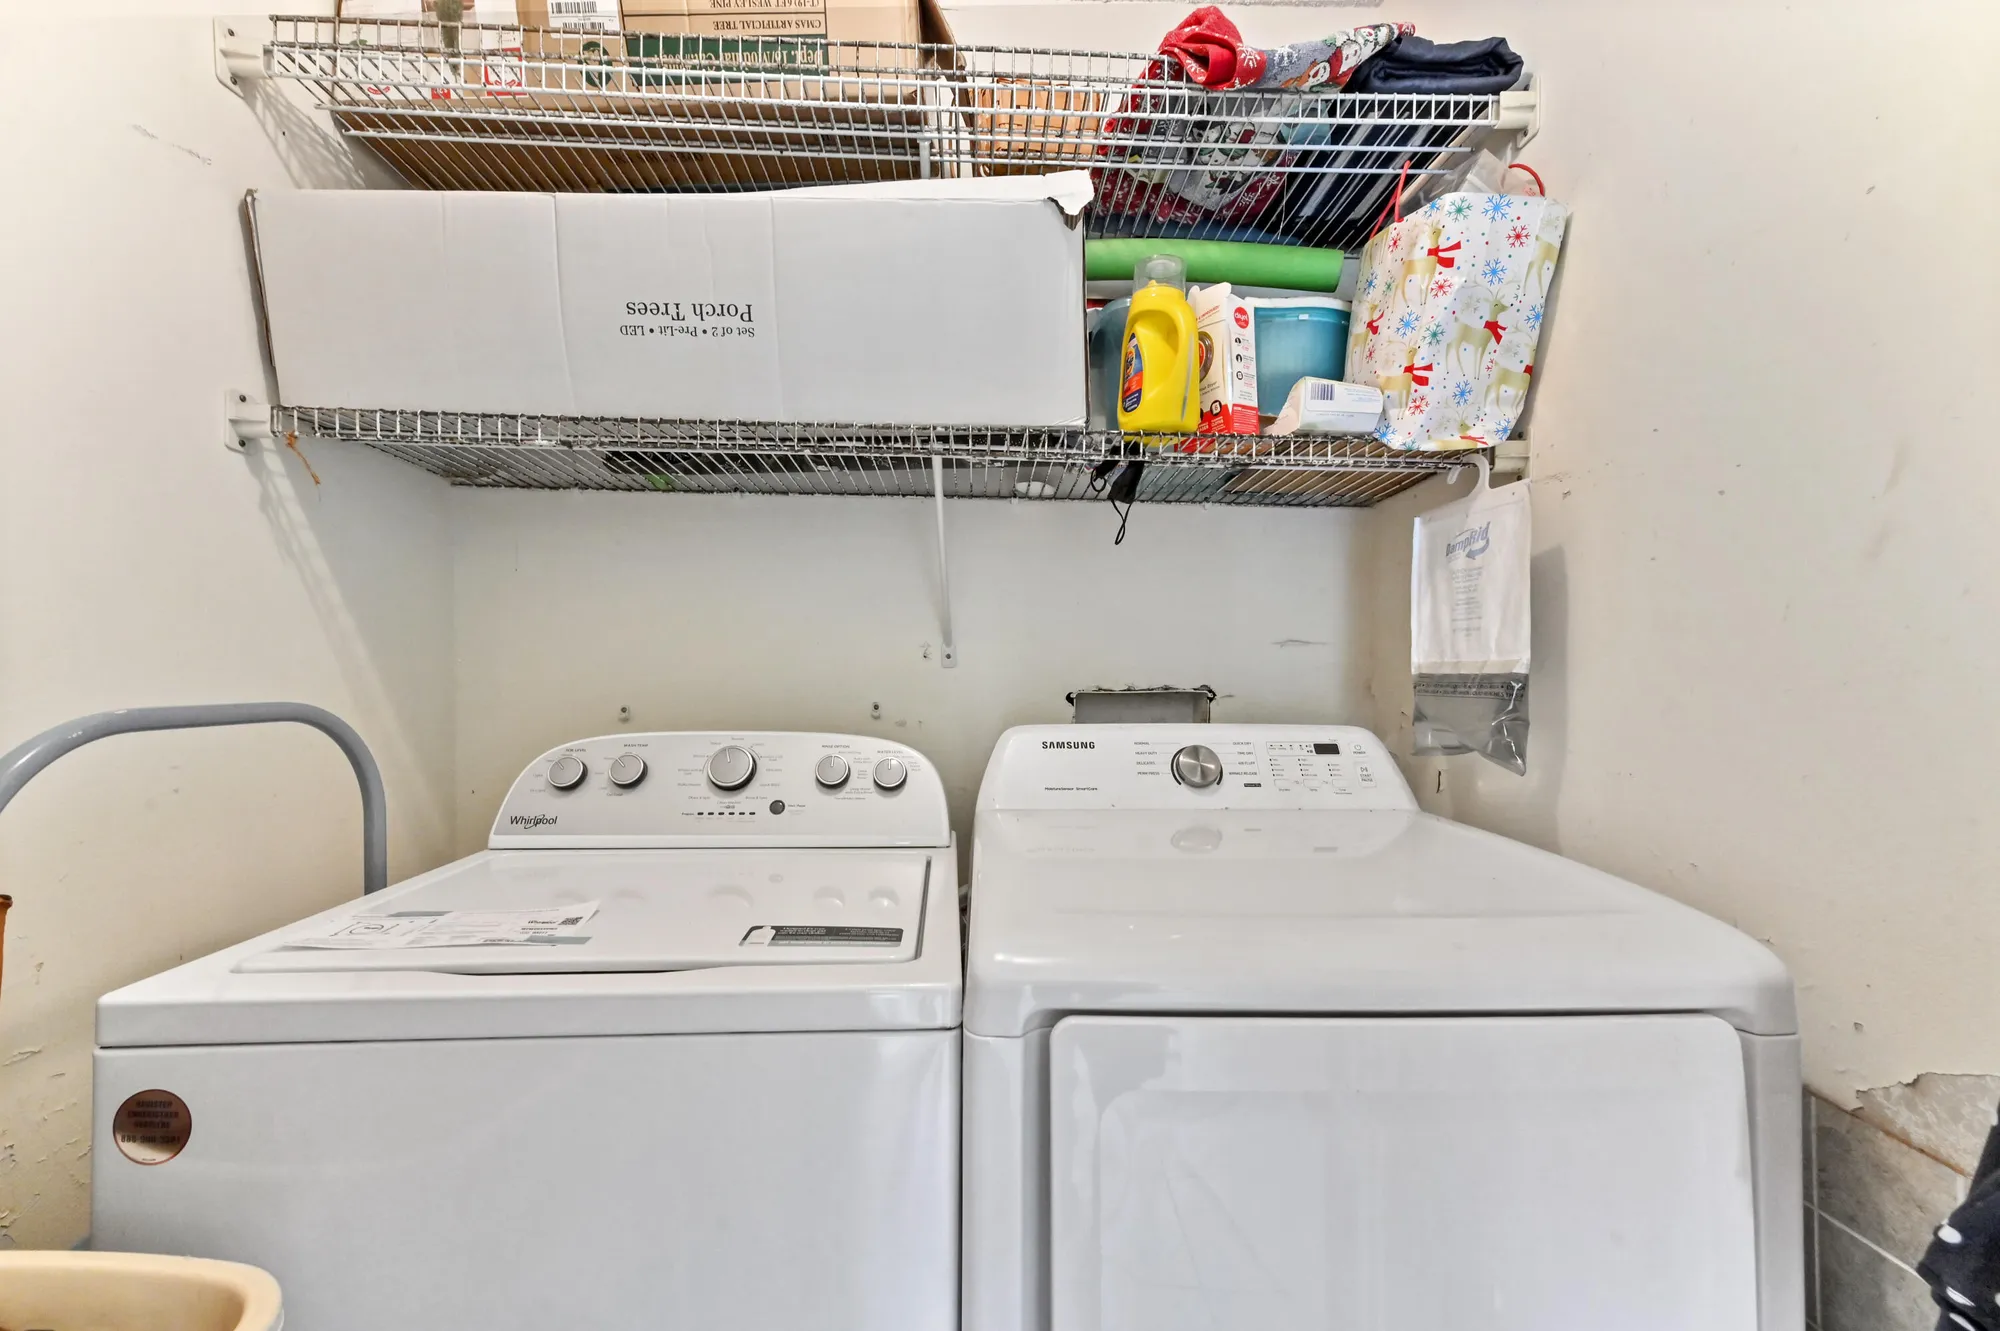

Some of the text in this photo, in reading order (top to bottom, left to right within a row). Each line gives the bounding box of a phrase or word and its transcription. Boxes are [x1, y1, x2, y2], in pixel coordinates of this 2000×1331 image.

[712, 19, 822, 30] CMAS ARTIFICIAL TREE
[626, 301, 754, 323] Porch Trees
[620, 325, 755, 338] Set of 2 Pre-Lit LED
[1445, 520, 1491, 557] DampRid
[1041, 740, 1096, 750] SAMSUNG
[510, 814, 558, 829] Whirlpool
